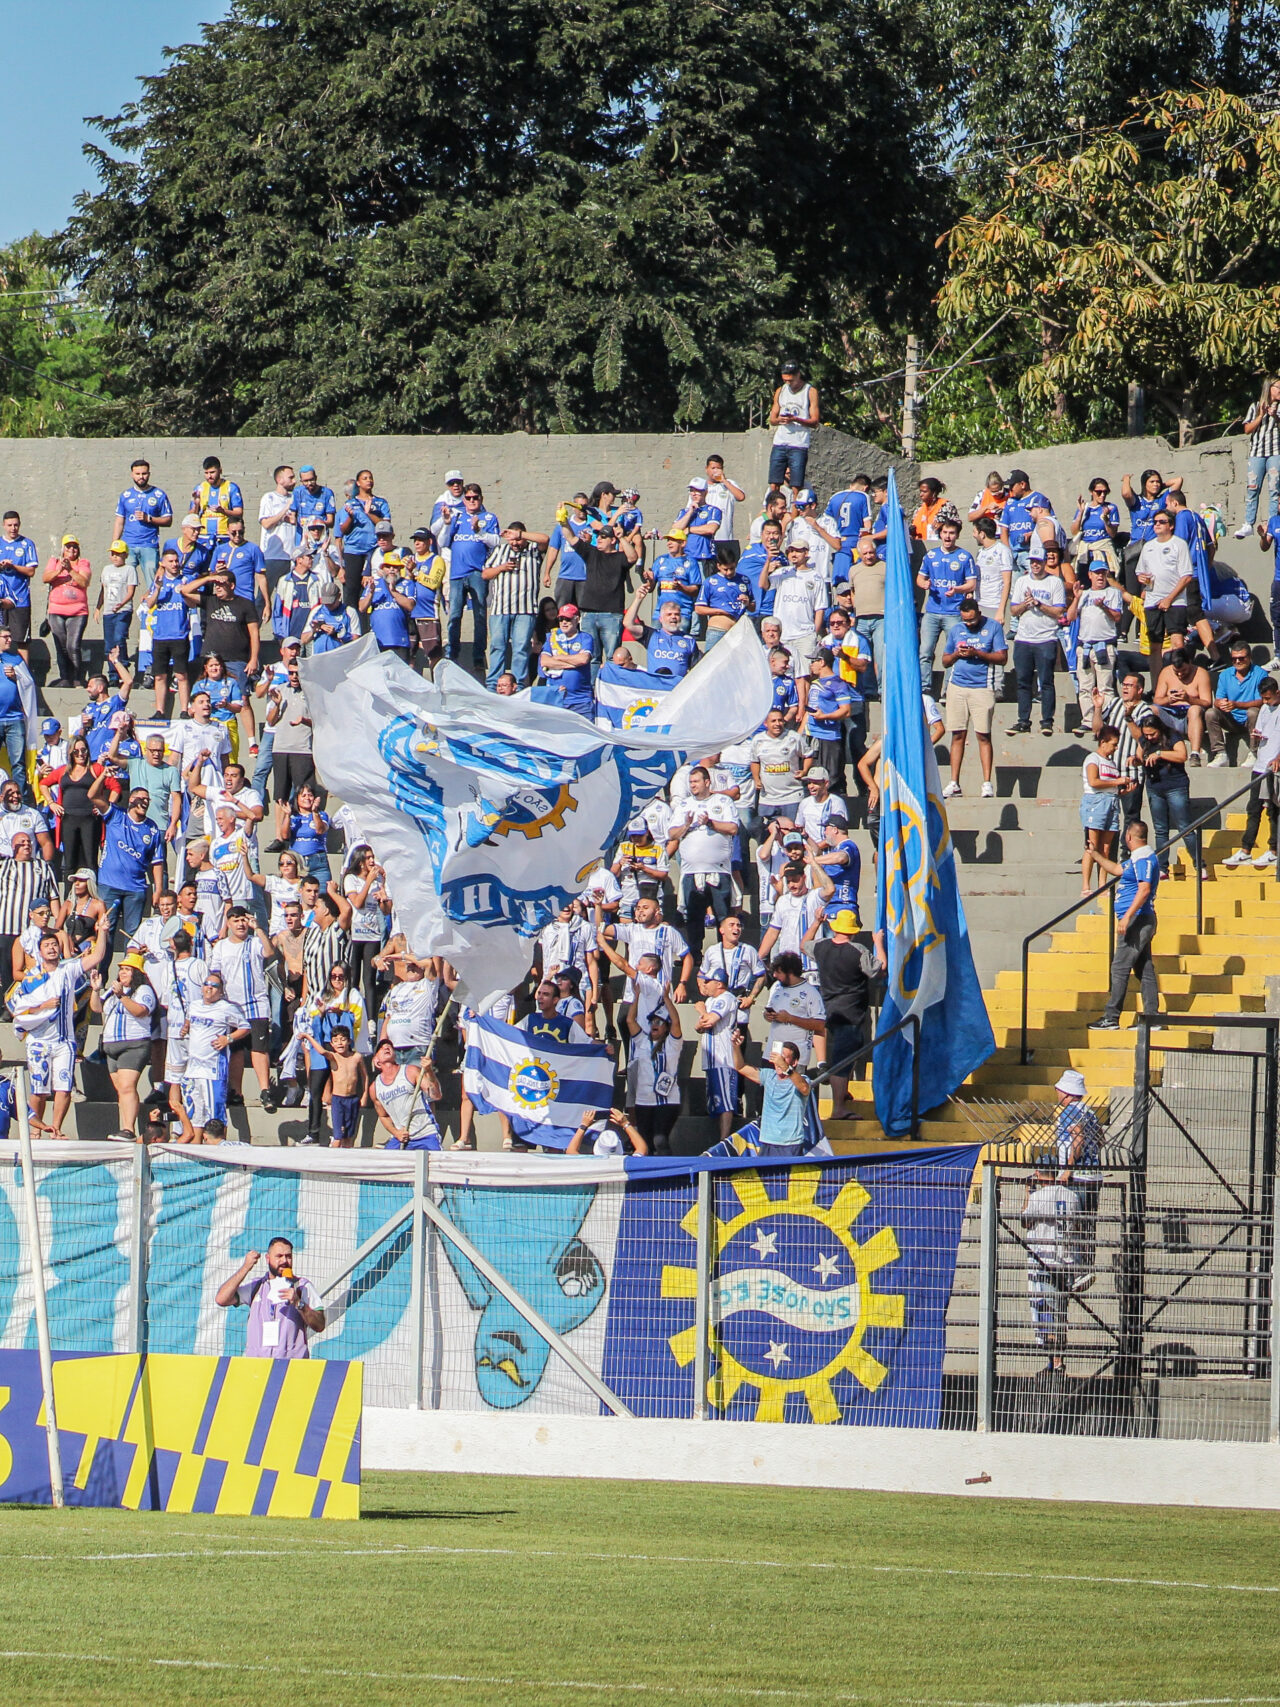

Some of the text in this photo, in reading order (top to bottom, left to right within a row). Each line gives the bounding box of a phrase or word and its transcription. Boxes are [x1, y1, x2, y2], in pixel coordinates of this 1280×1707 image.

[839, 502, 851, 528] 9
[757, 1279, 809, 1308] JOSÉ
[814, 1296, 851, 1325] SÃO
